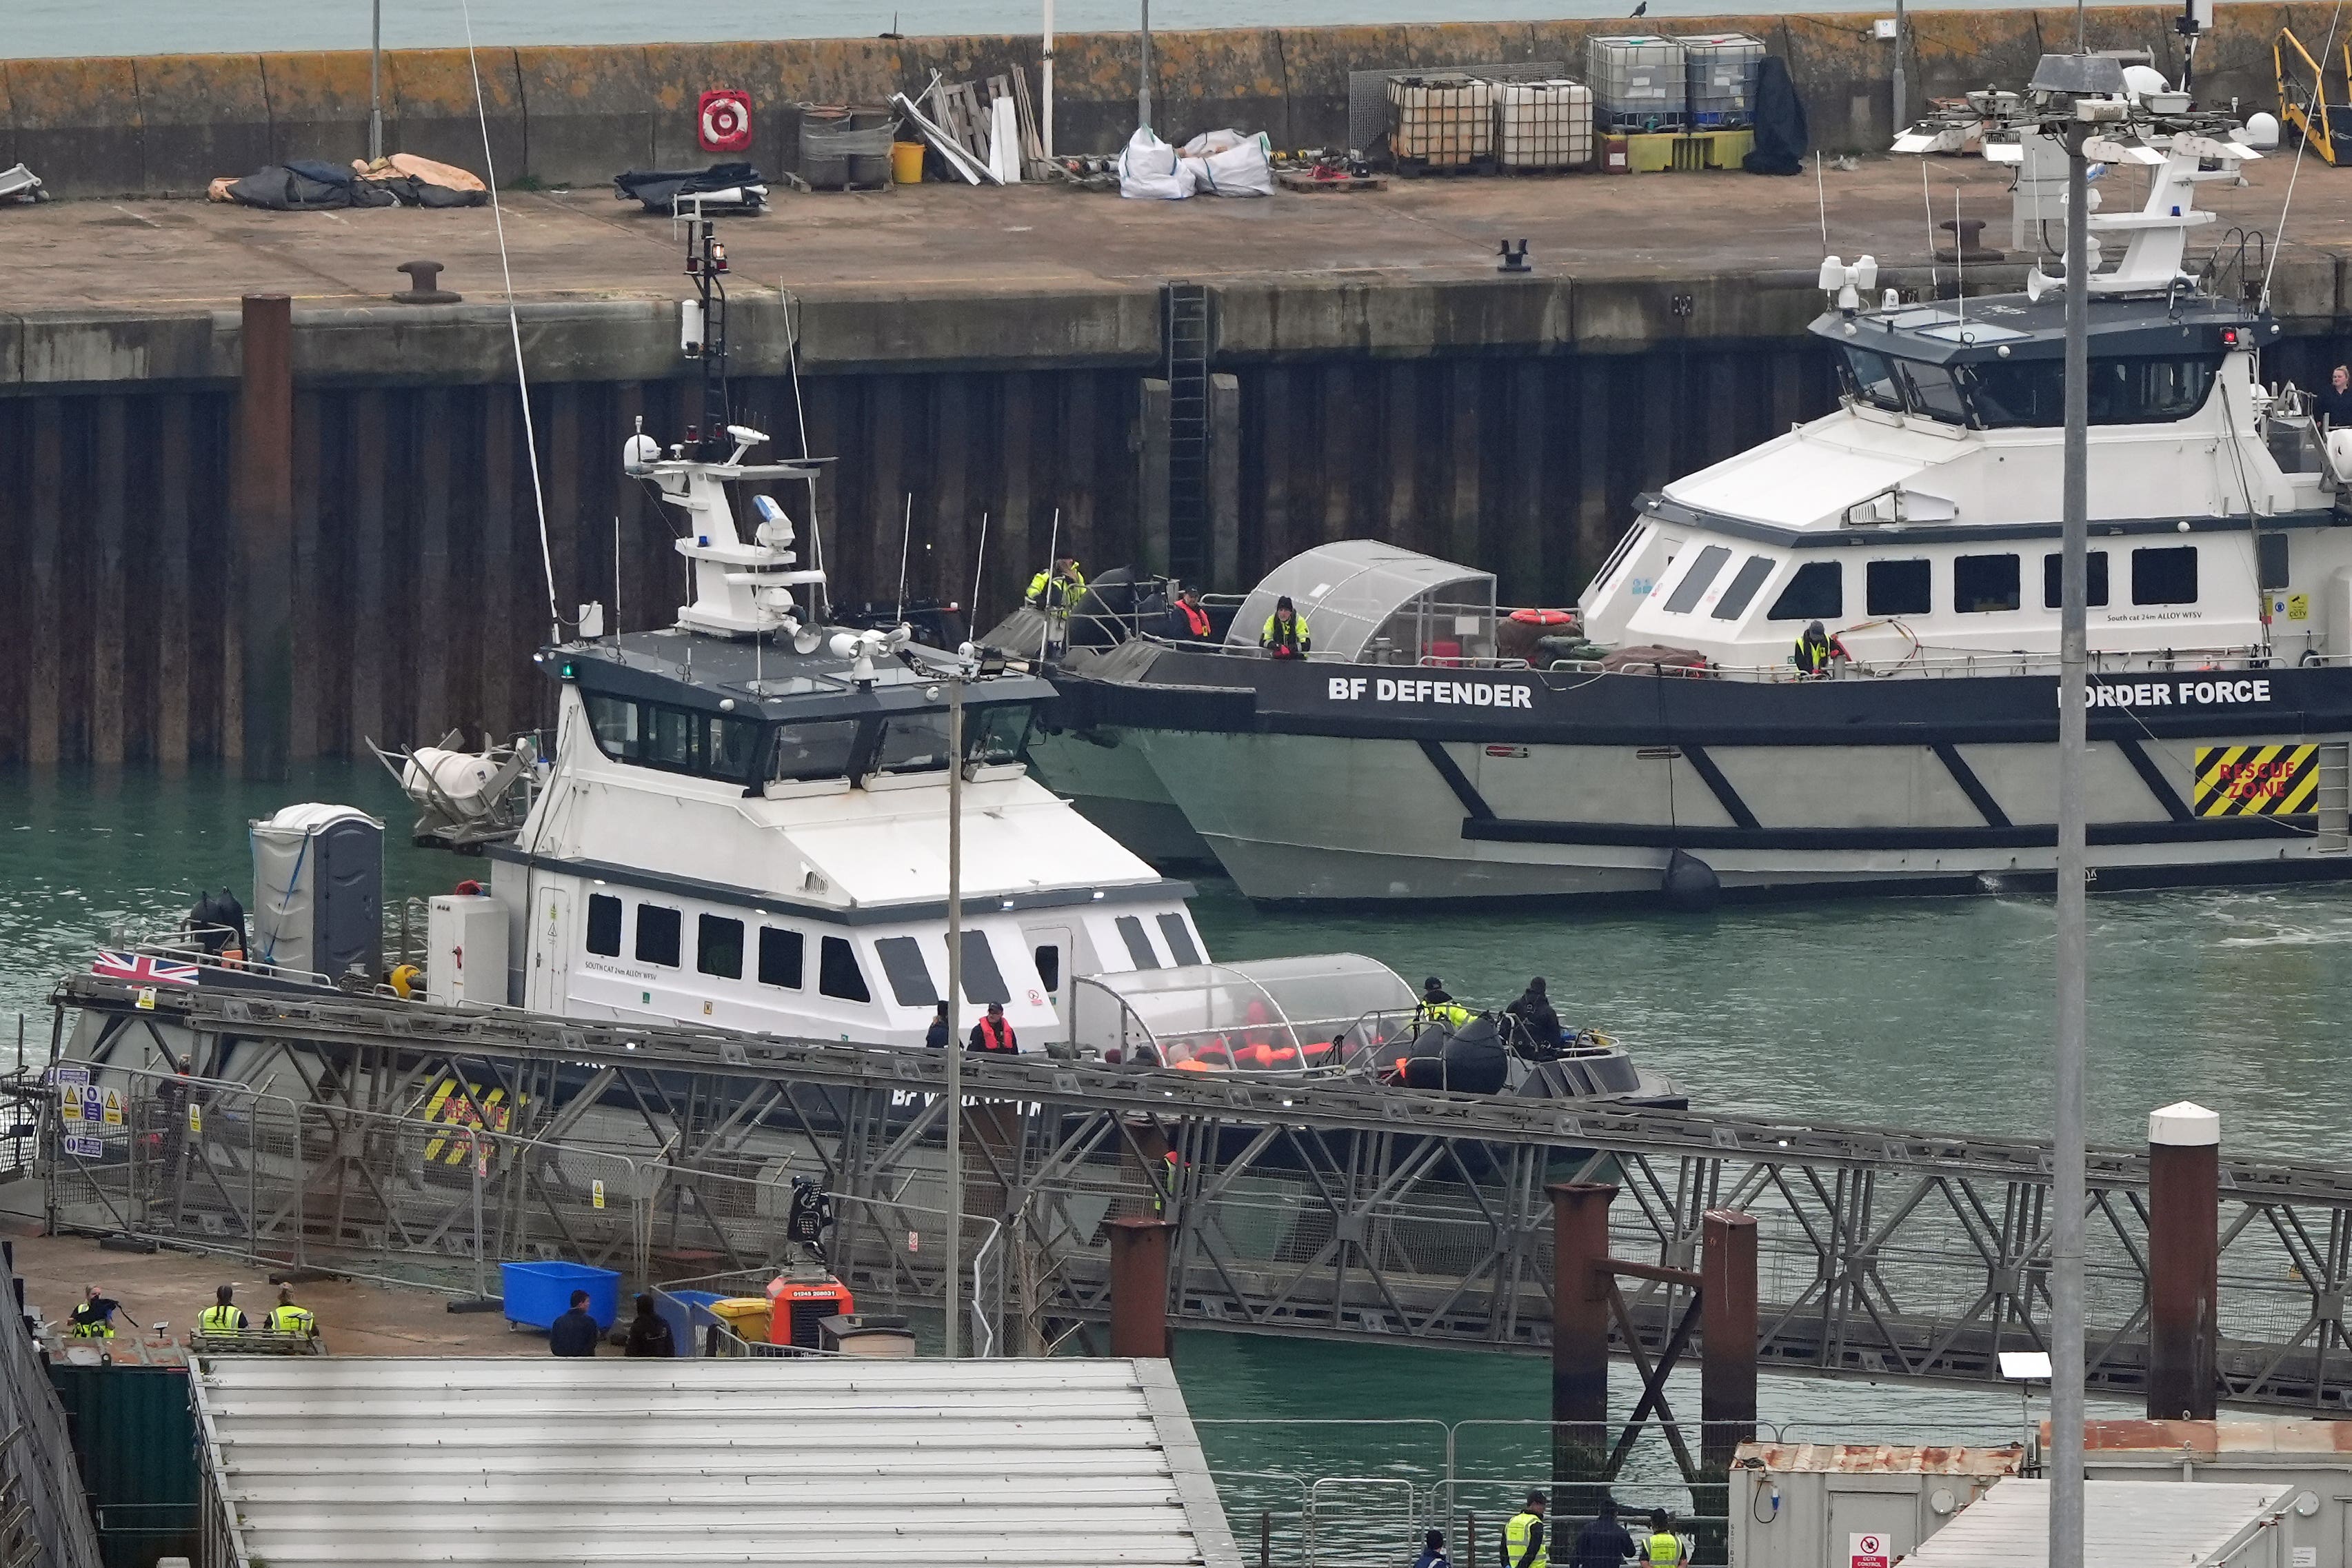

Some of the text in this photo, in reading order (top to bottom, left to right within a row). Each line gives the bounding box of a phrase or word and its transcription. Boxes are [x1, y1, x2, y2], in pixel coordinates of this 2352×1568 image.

[1329, 678, 1533, 708] BF DEFENDER
[2057, 680, 2271, 708] ORDER FORCE
[2220, 762, 2295, 779] RESCUE
[2229, 781, 2286, 798] ZONE
[585, 961, 603, 971] SOUTH
[626, 969, 641, 978] ALLOY
